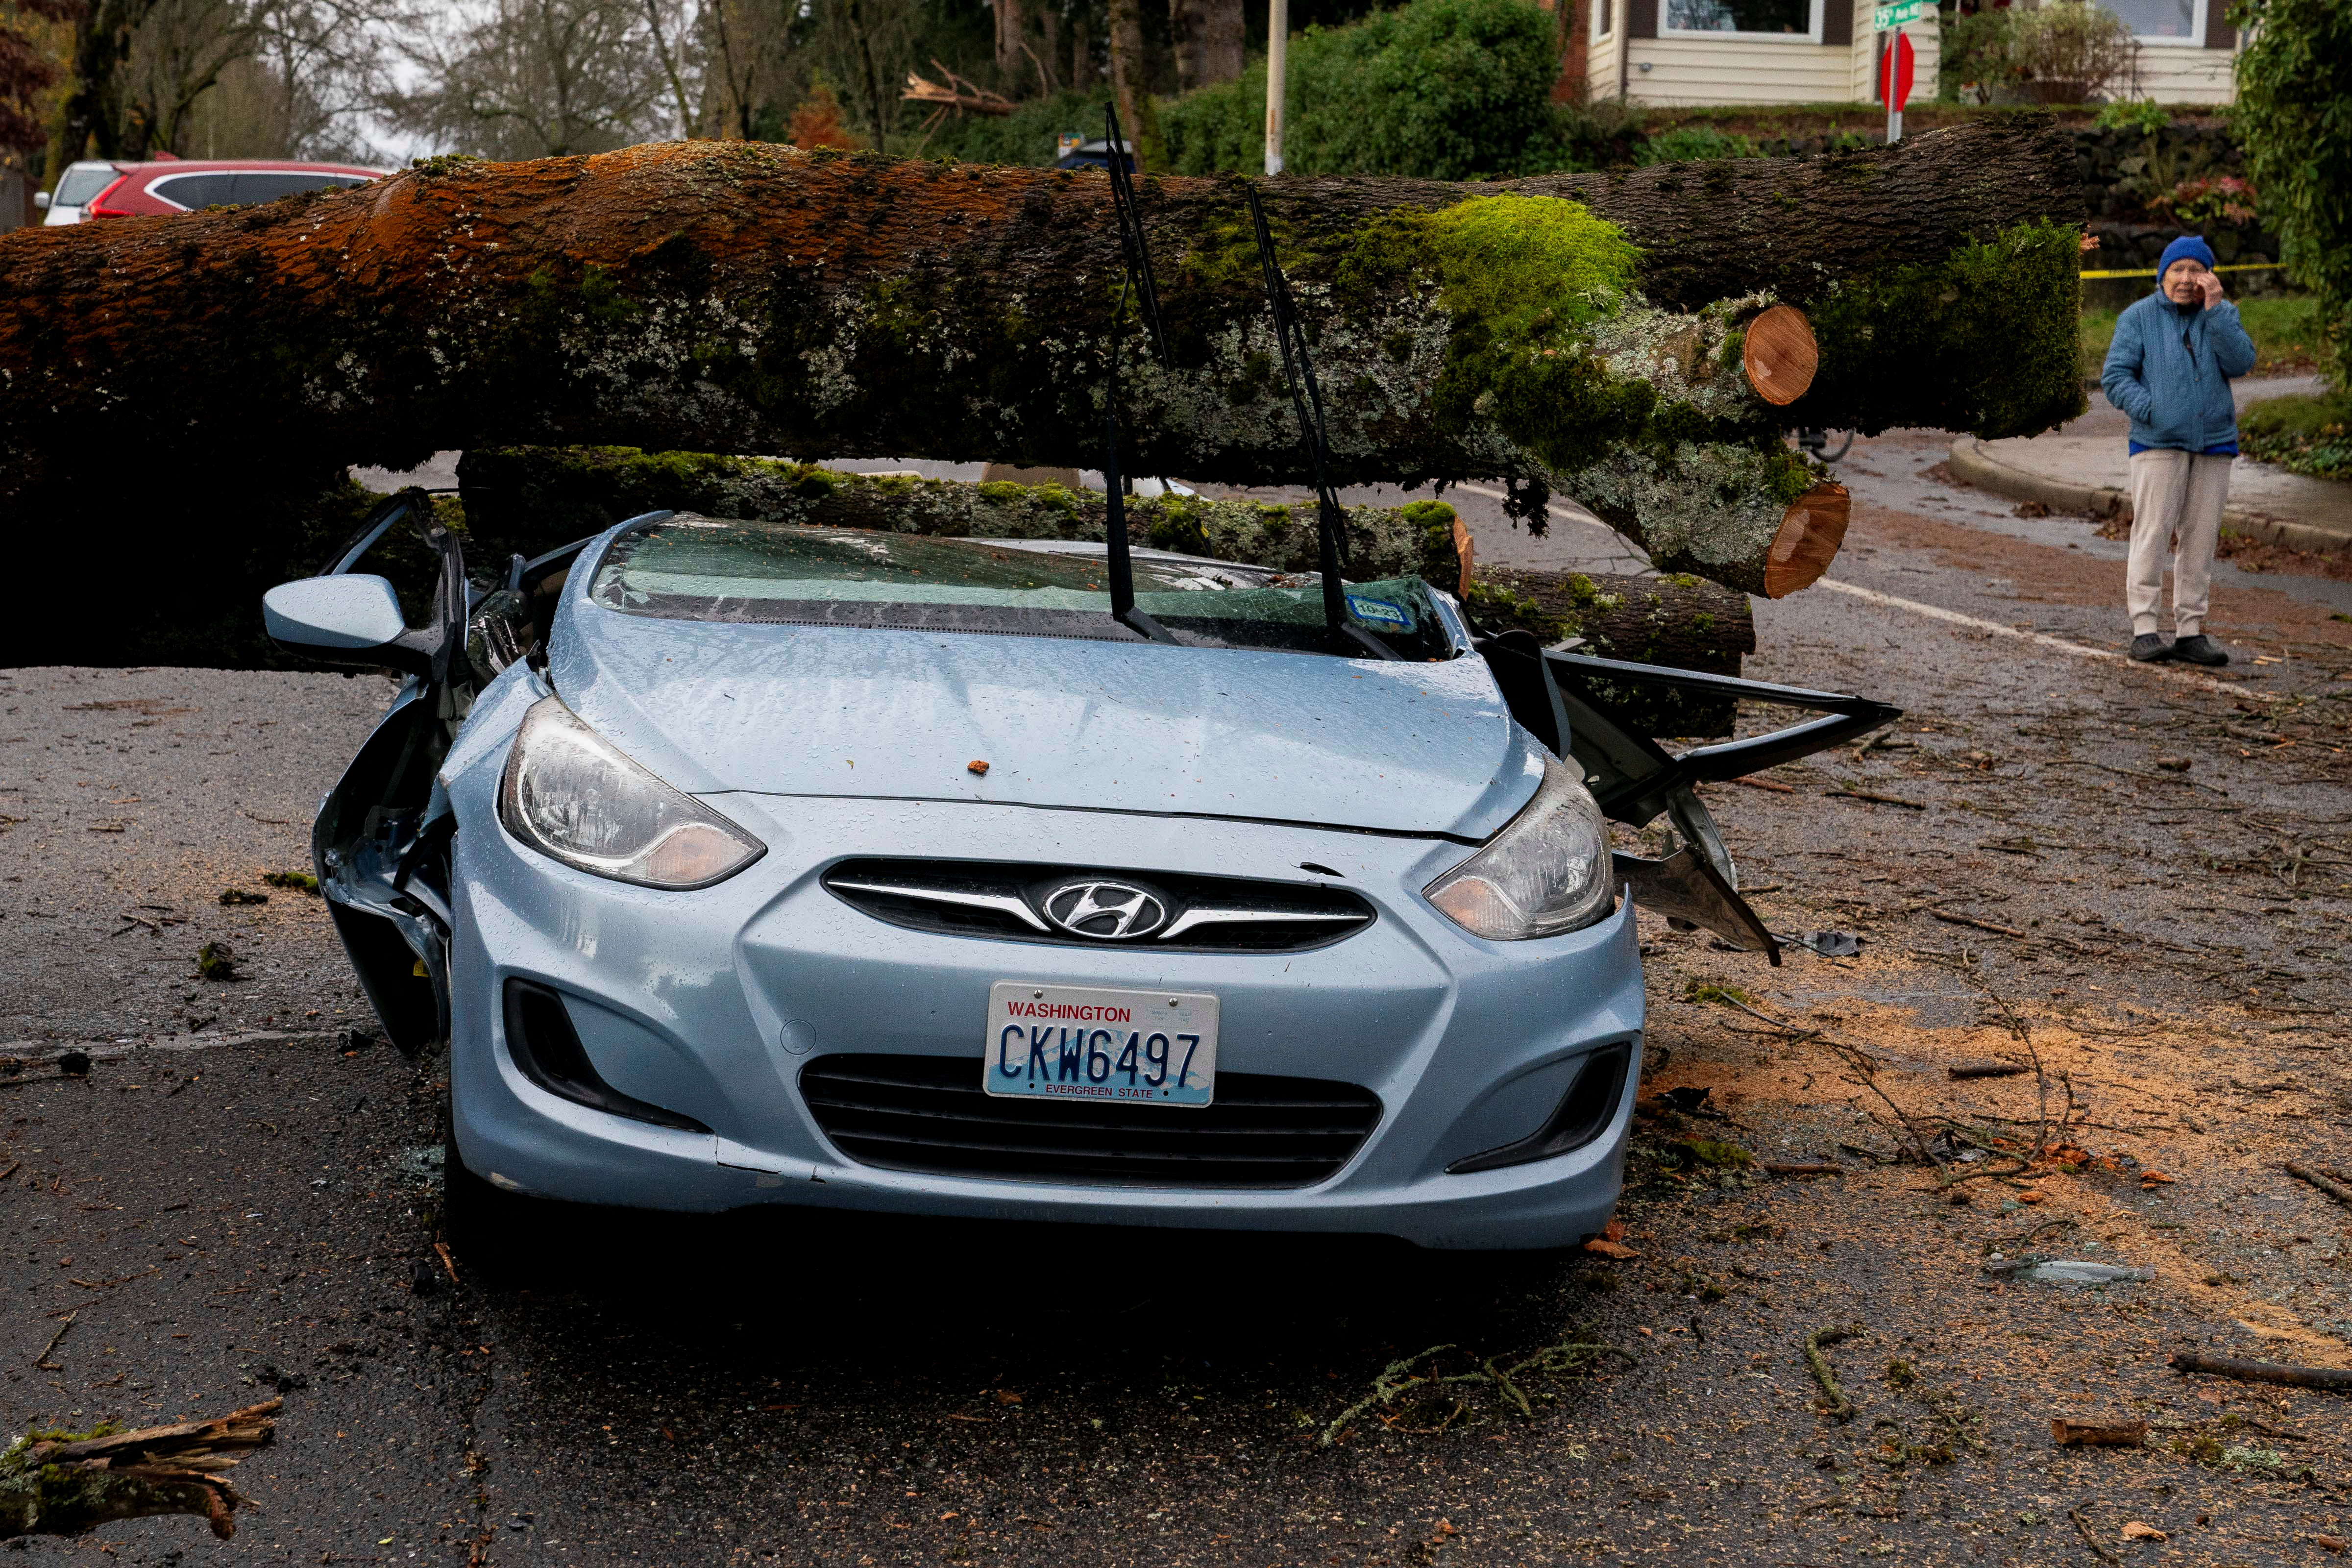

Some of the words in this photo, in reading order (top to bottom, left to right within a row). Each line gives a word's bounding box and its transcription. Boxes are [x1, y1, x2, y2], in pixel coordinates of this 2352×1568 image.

[1007, 1001, 1130, 1023] WASHINGTON
[999, 1024, 1200, 1088] CKW6497
[1046, 1084, 1113, 1096] EVERGREEN
[1118, 1088, 1153, 1098] STATE
